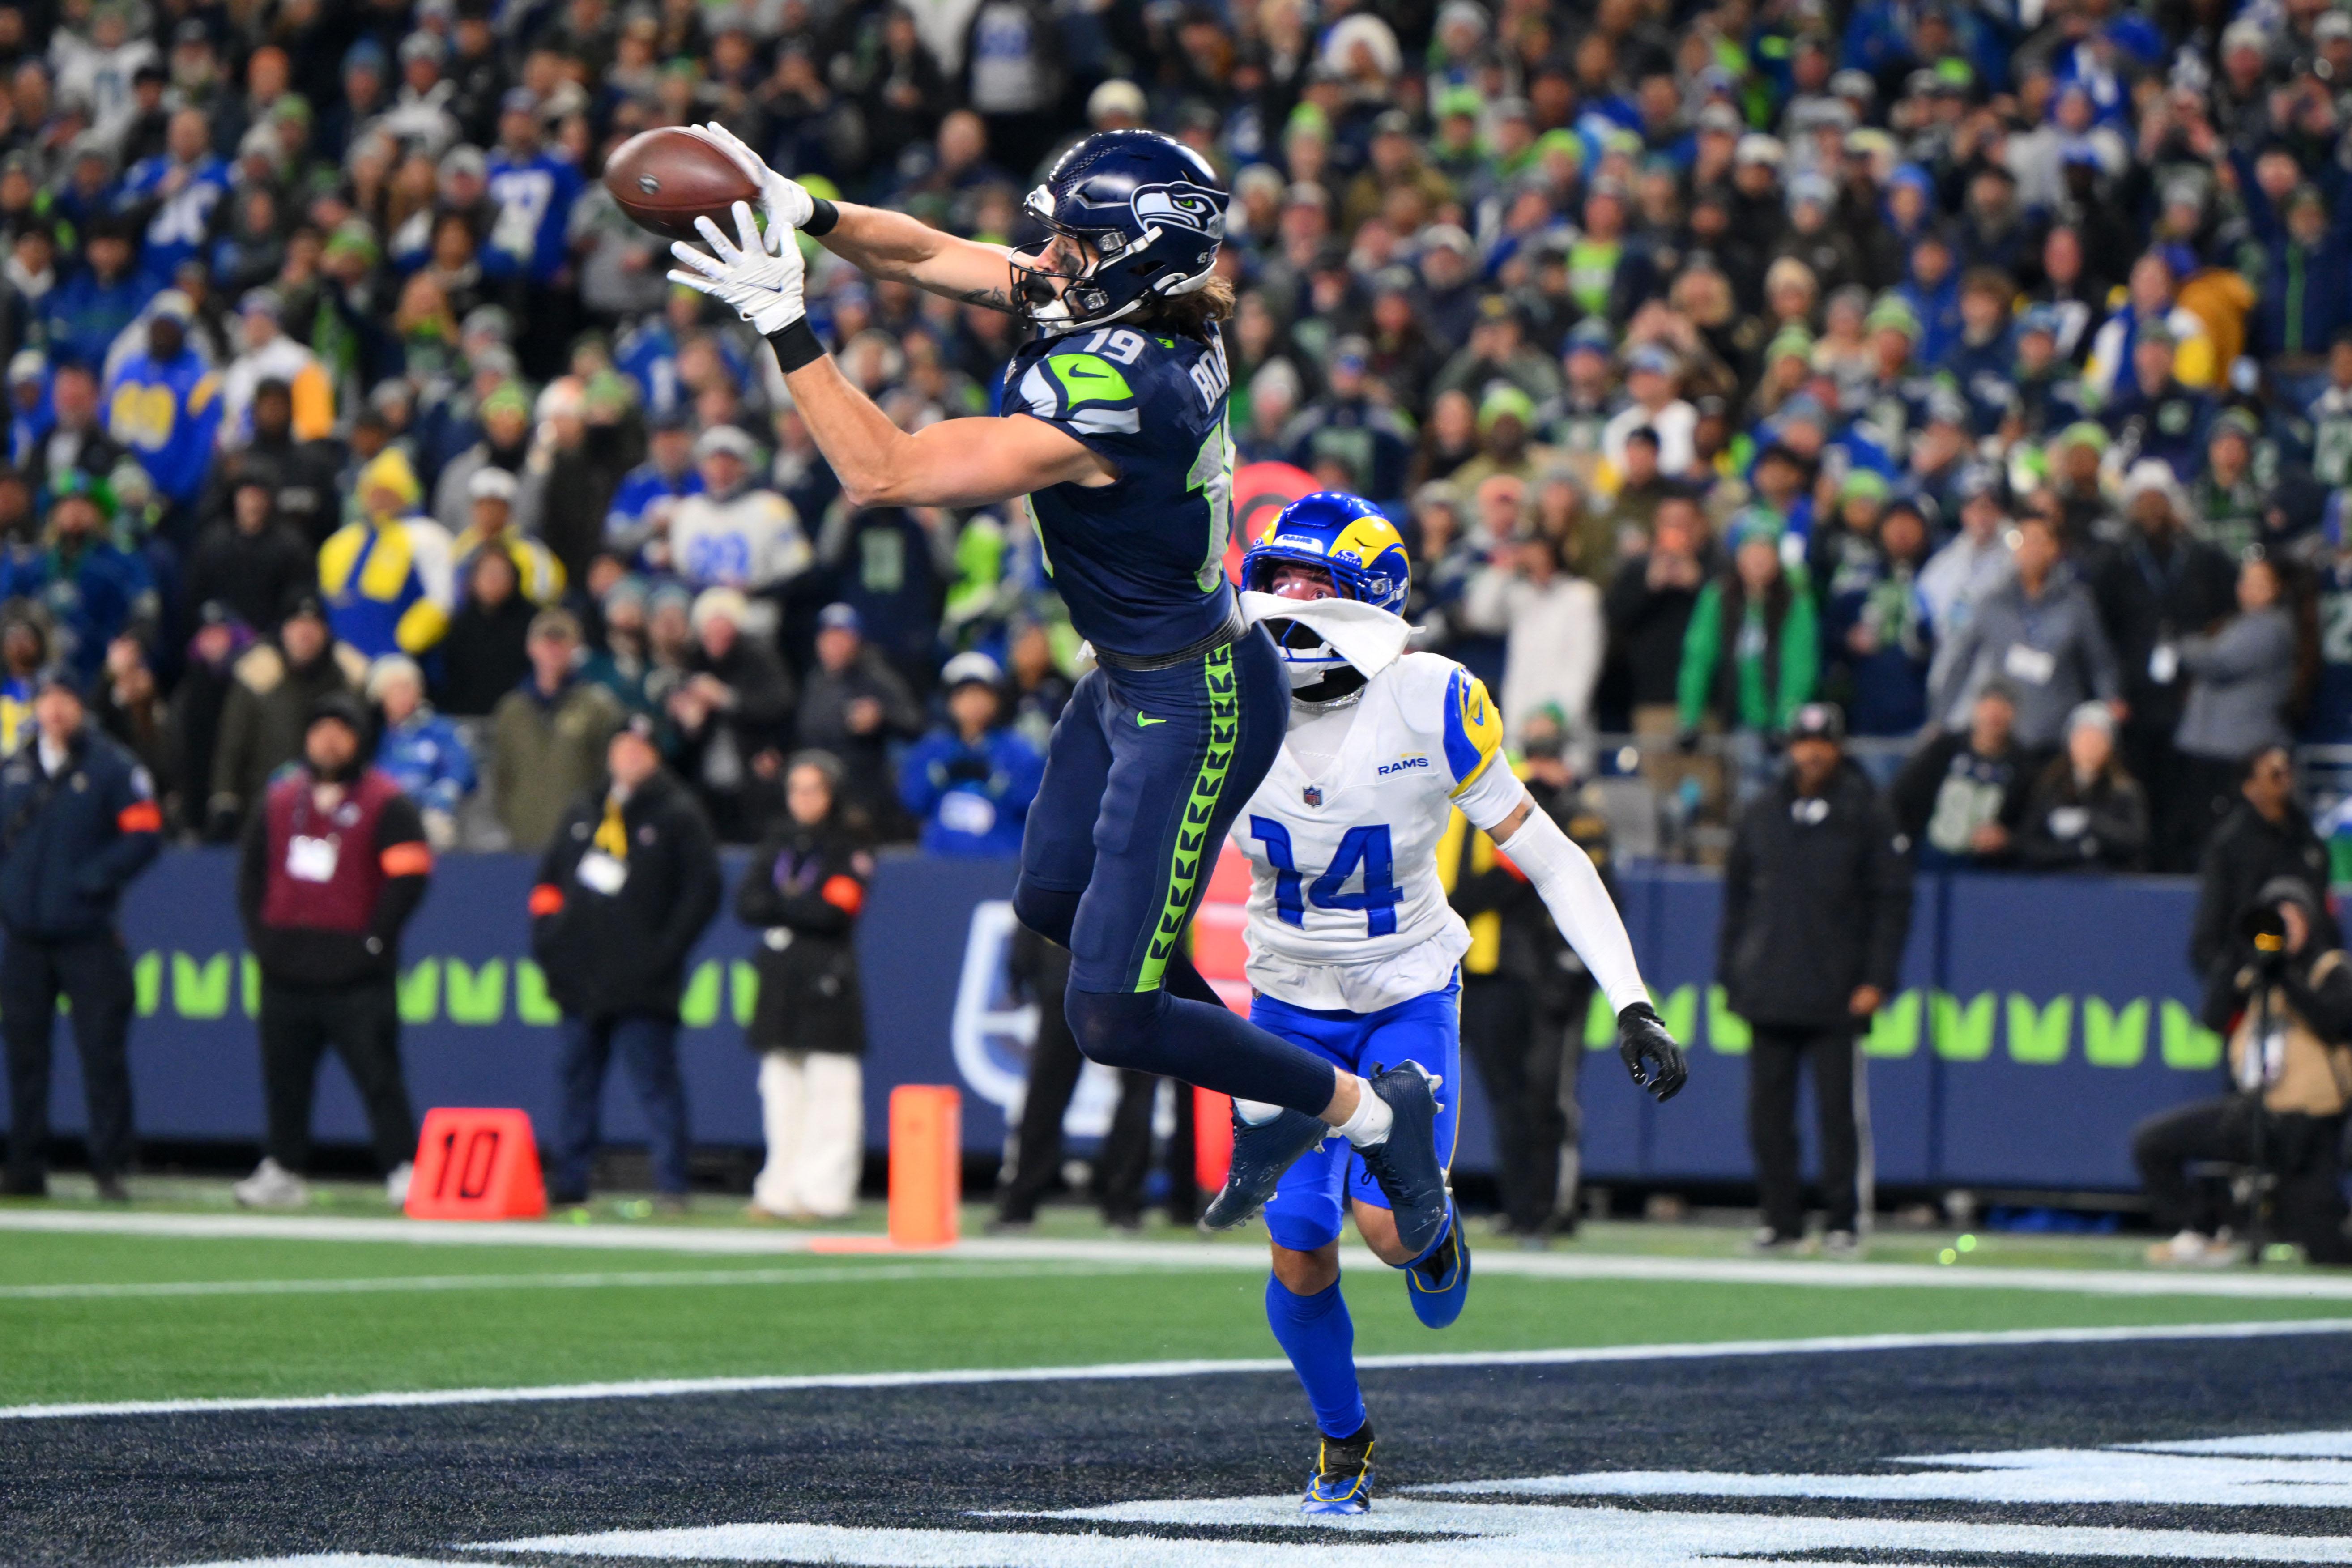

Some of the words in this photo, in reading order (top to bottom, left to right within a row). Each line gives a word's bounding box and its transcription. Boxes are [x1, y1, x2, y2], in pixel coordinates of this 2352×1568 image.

[1083, 327, 1145, 365] 19
[1378, 758, 1429, 775] RAMS
[1249, 814, 1404, 938] 14
[433, 1129, 499, 1201] 10
